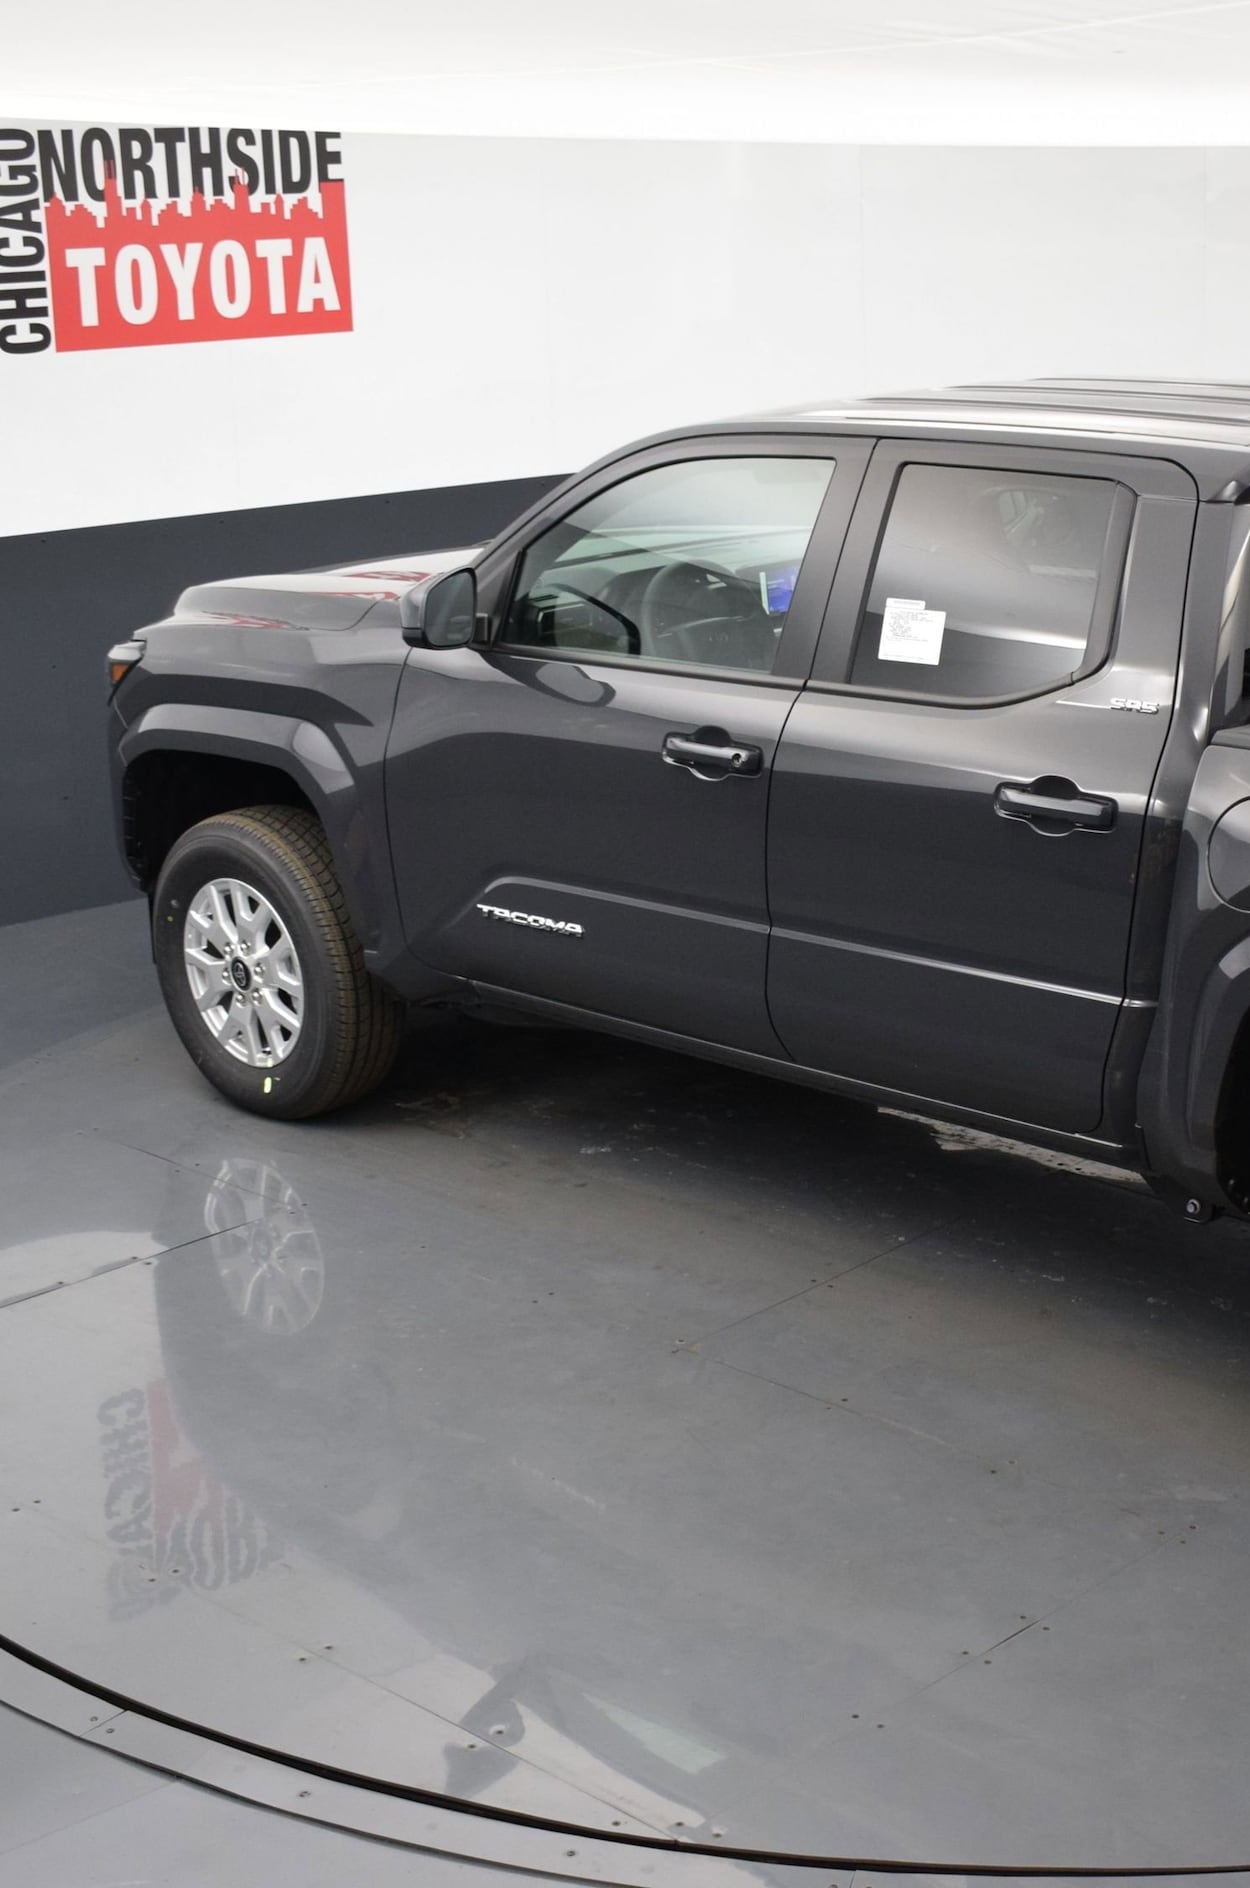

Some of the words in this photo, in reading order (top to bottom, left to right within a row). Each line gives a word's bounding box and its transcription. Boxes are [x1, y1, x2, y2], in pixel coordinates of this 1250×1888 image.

[37, 127, 345, 203] NORTHSIDE
[0, 128, 51, 355] CHICAGO
[65, 237, 342, 328] TOYOTA
[476, 903, 586, 938] TACOMA
